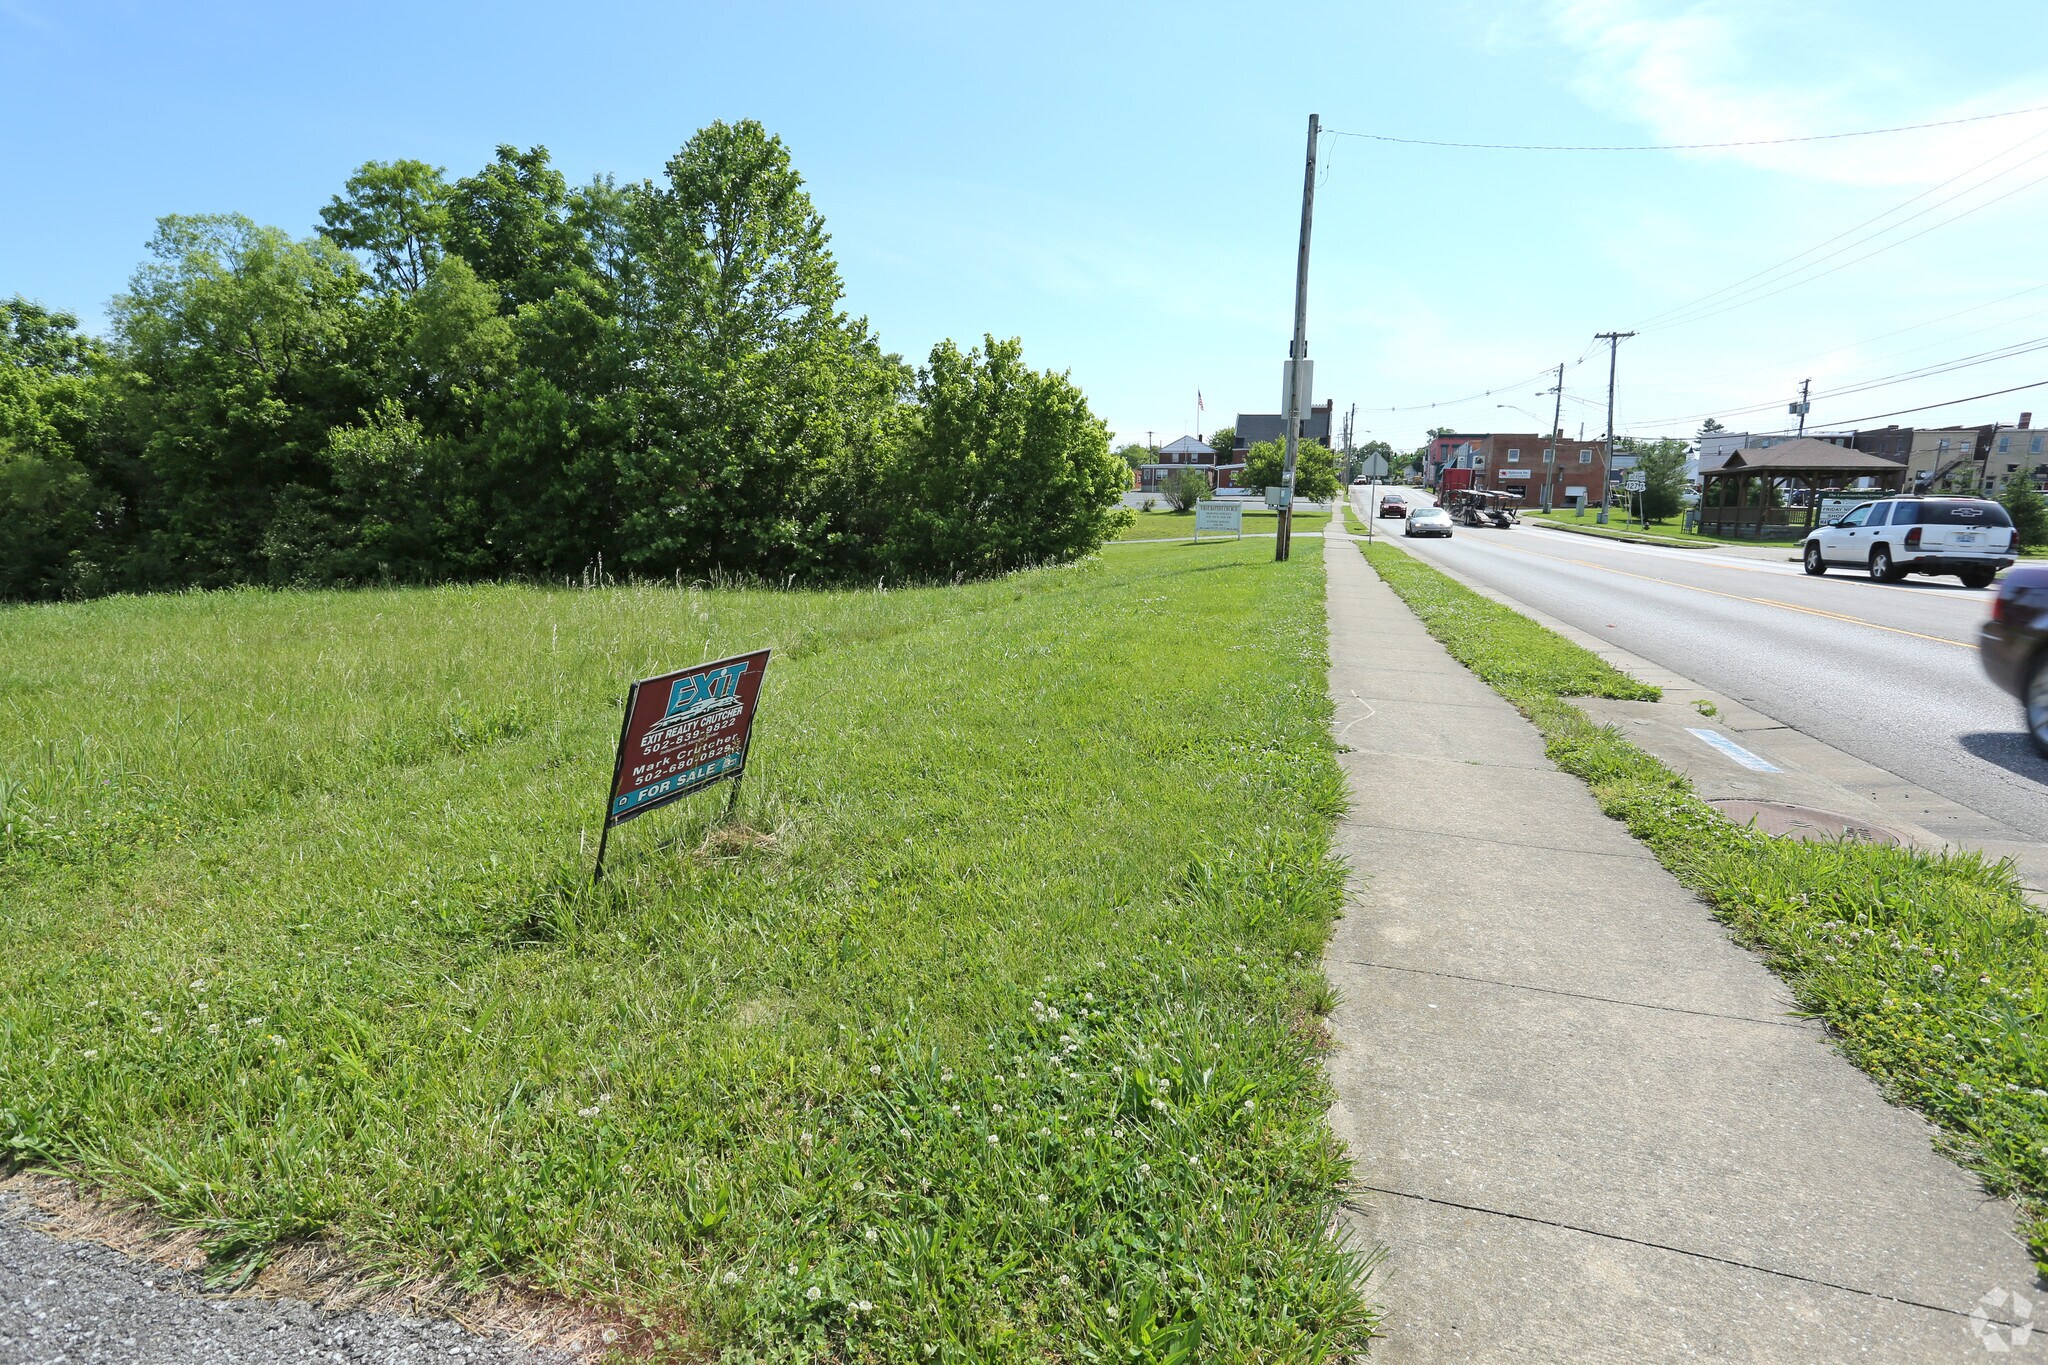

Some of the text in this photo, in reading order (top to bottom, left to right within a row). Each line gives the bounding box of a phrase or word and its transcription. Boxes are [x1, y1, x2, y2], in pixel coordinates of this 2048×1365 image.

[640, 732, 663, 748] EXIT
[665, 721, 698, 740] REALTY
[700, 706, 743, 727] CRUTCHER
[643, 718, 736, 755] 502-839-9822
[632, 733, 738, 776] Mark Crutcher
[635, 745, 731, 786] 502-680-0829
[637, 763, 717, 802] FOR SALE
